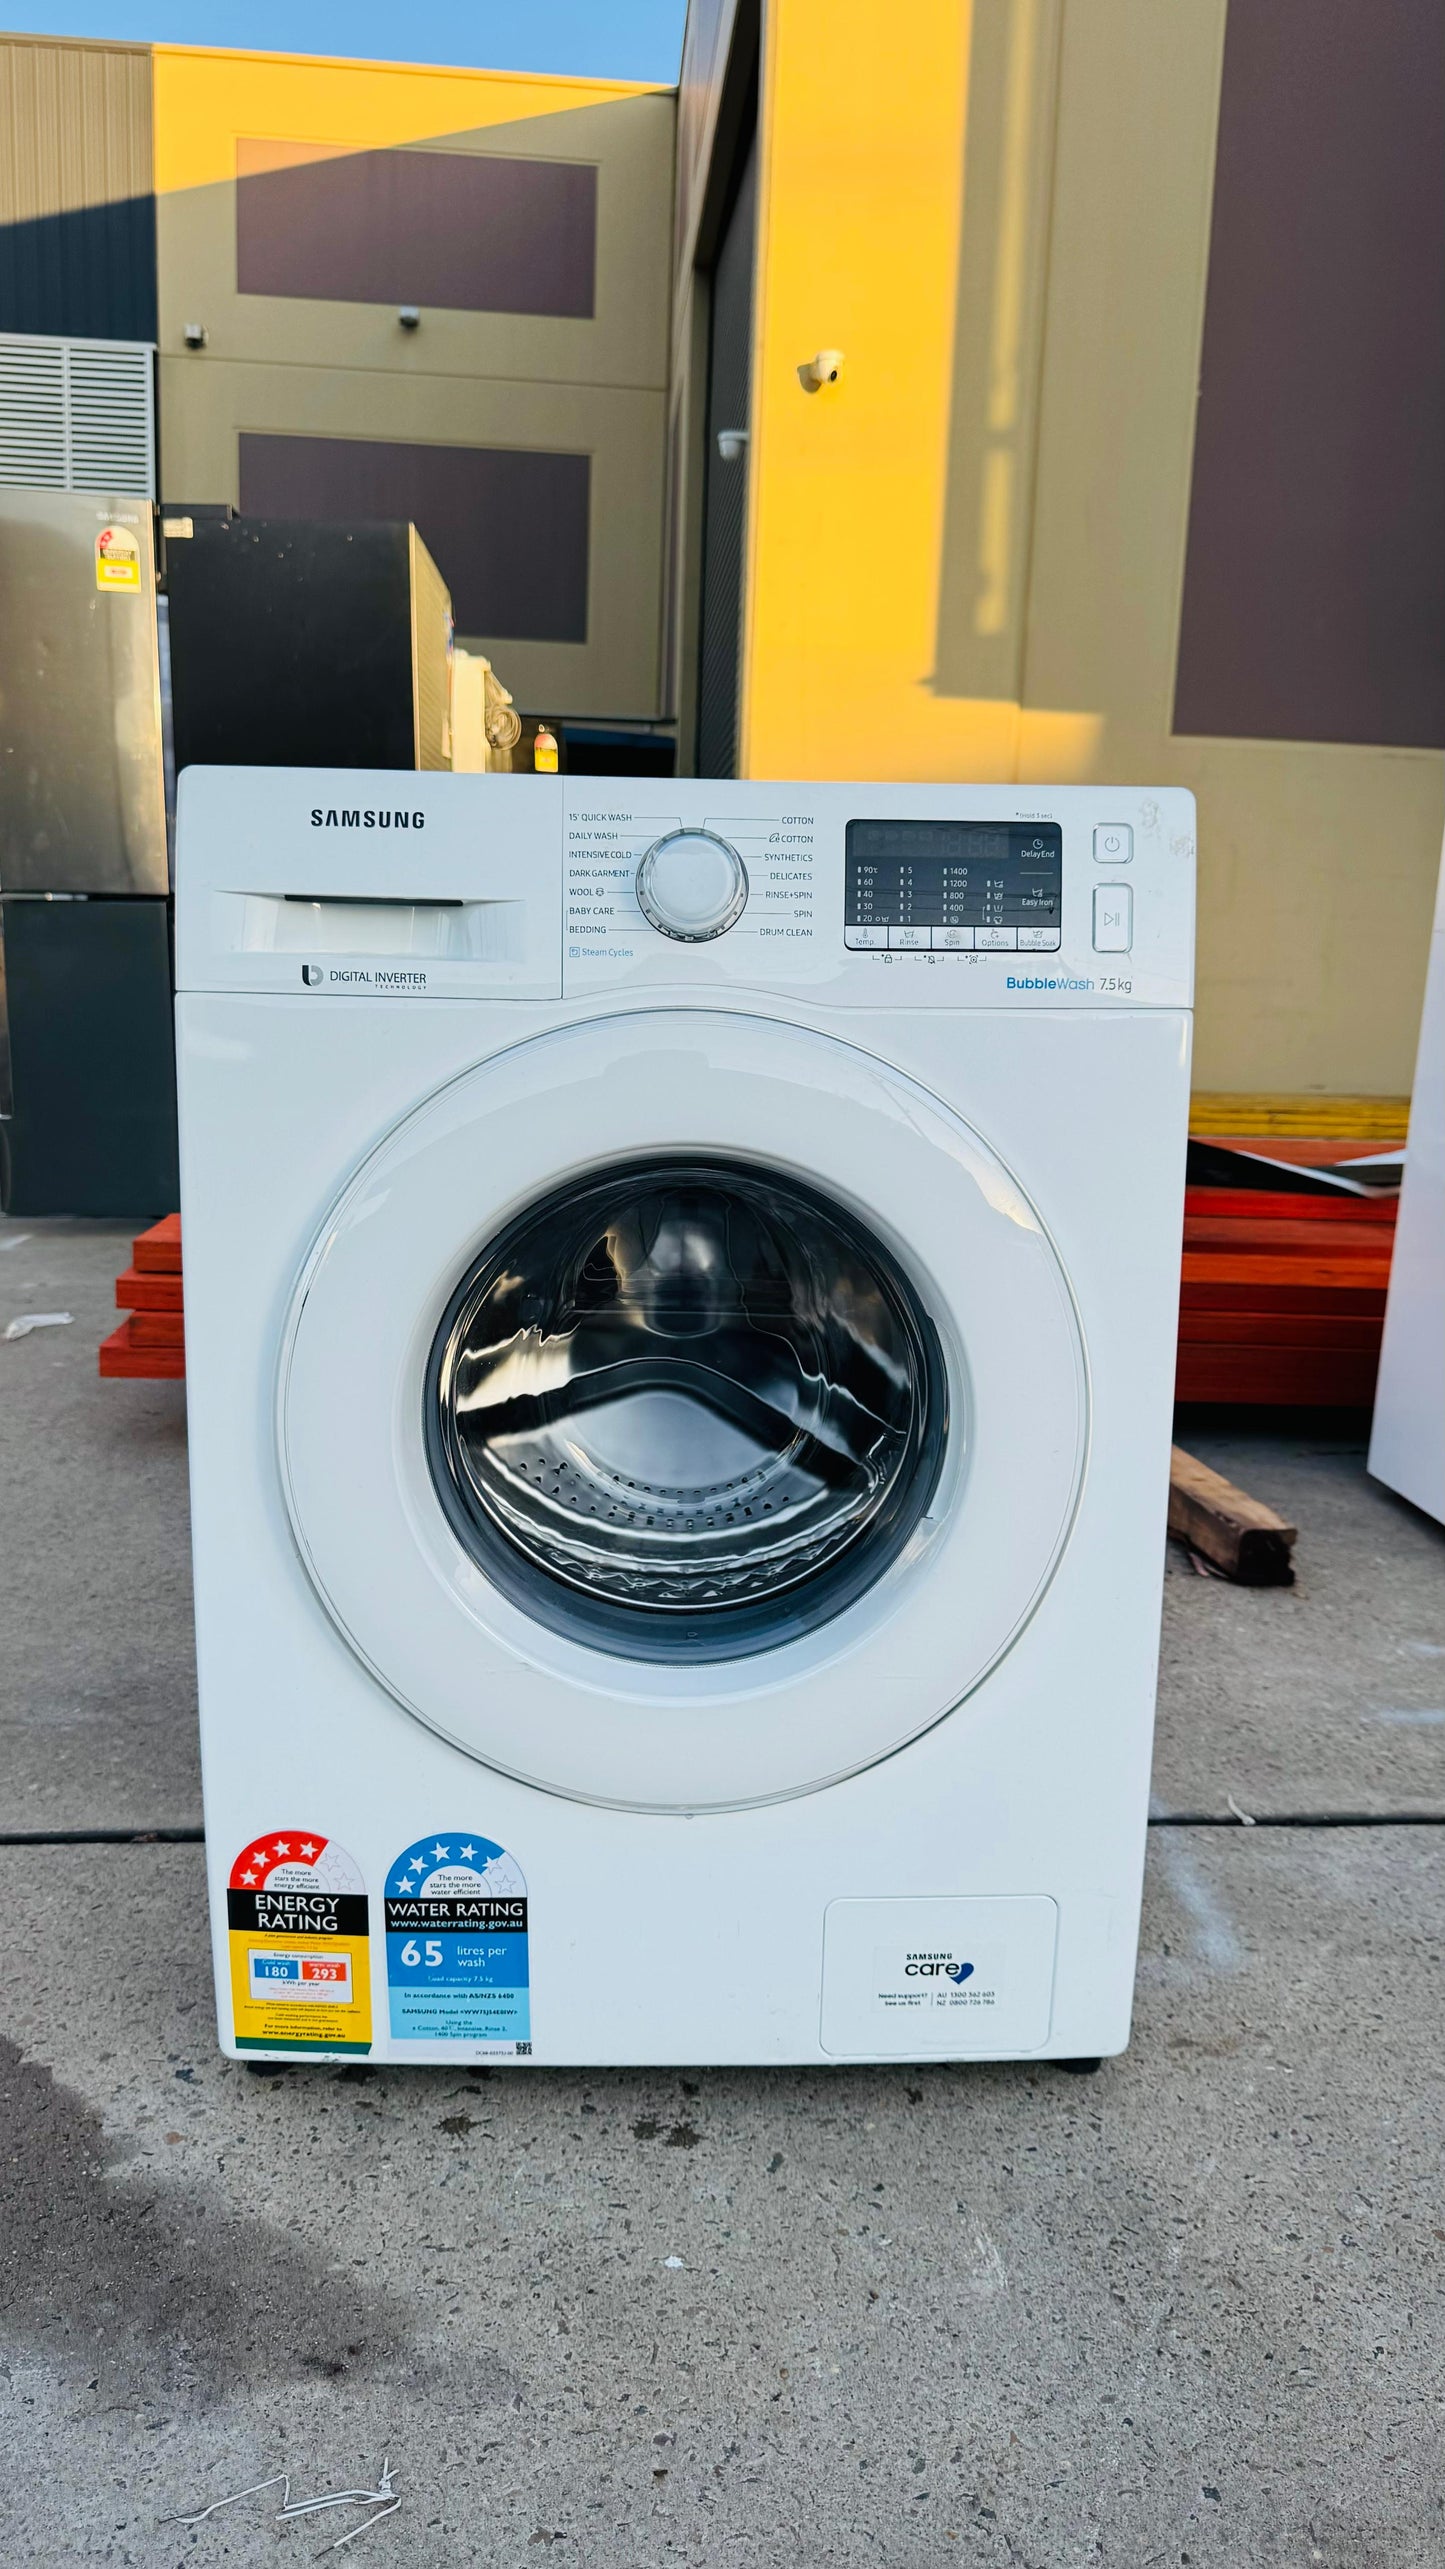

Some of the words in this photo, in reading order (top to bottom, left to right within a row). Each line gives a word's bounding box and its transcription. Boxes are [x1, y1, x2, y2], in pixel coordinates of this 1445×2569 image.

[310, 809, 425, 829] SAMSUNG
[581, 814, 607, 822] QUICK
[781, 817, 814, 825] COTTON
[781, 836, 814, 844] COTTON
[764, 854, 813, 862] SYNTHETICS
[1021, 851, 1041, 859] Delay
[569, 870, 591, 878] DARK
[592, 870, 629, 878] GARMENT
[770, 872, 812, 881] DELICATES
[765, 891, 812, 899] RINSE+SPIN
[794, 910, 812, 918] SPIN
[569, 926, 607, 934] BEDDING
[760, 928, 784, 936] DRUM
[786, 929, 812, 937] CLEAN
[944, 939, 960, 947] Spin
[982, 939, 1009, 948] Options
[582, 948, 607, 956] Steam
[608, 948, 634, 958] Cycles
[330, 970, 372, 982] DIGITAL
[375, 972, 426, 984] INVERTER
[1006, 977, 1094, 991] BubbleWash
[255, 1894, 339, 1913] ENERGY
[388, 1902, 450, 1916] WATER
[456, 1903, 523, 1916] RATING
[258, 1913, 338, 1931] RATING
[391, 1919, 523, 1929] www.waterrating.gov.au
[401, 1940, 443, 1967] 65
[457, 1946, 484, 1956] litres
[488, 1948, 507, 1958] per
[458, 1958, 485, 1967] wash
[264, 1966, 288, 1977] 180
[312, 1968, 337, 1979] 293
[905, 1962, 960, 1976] care
